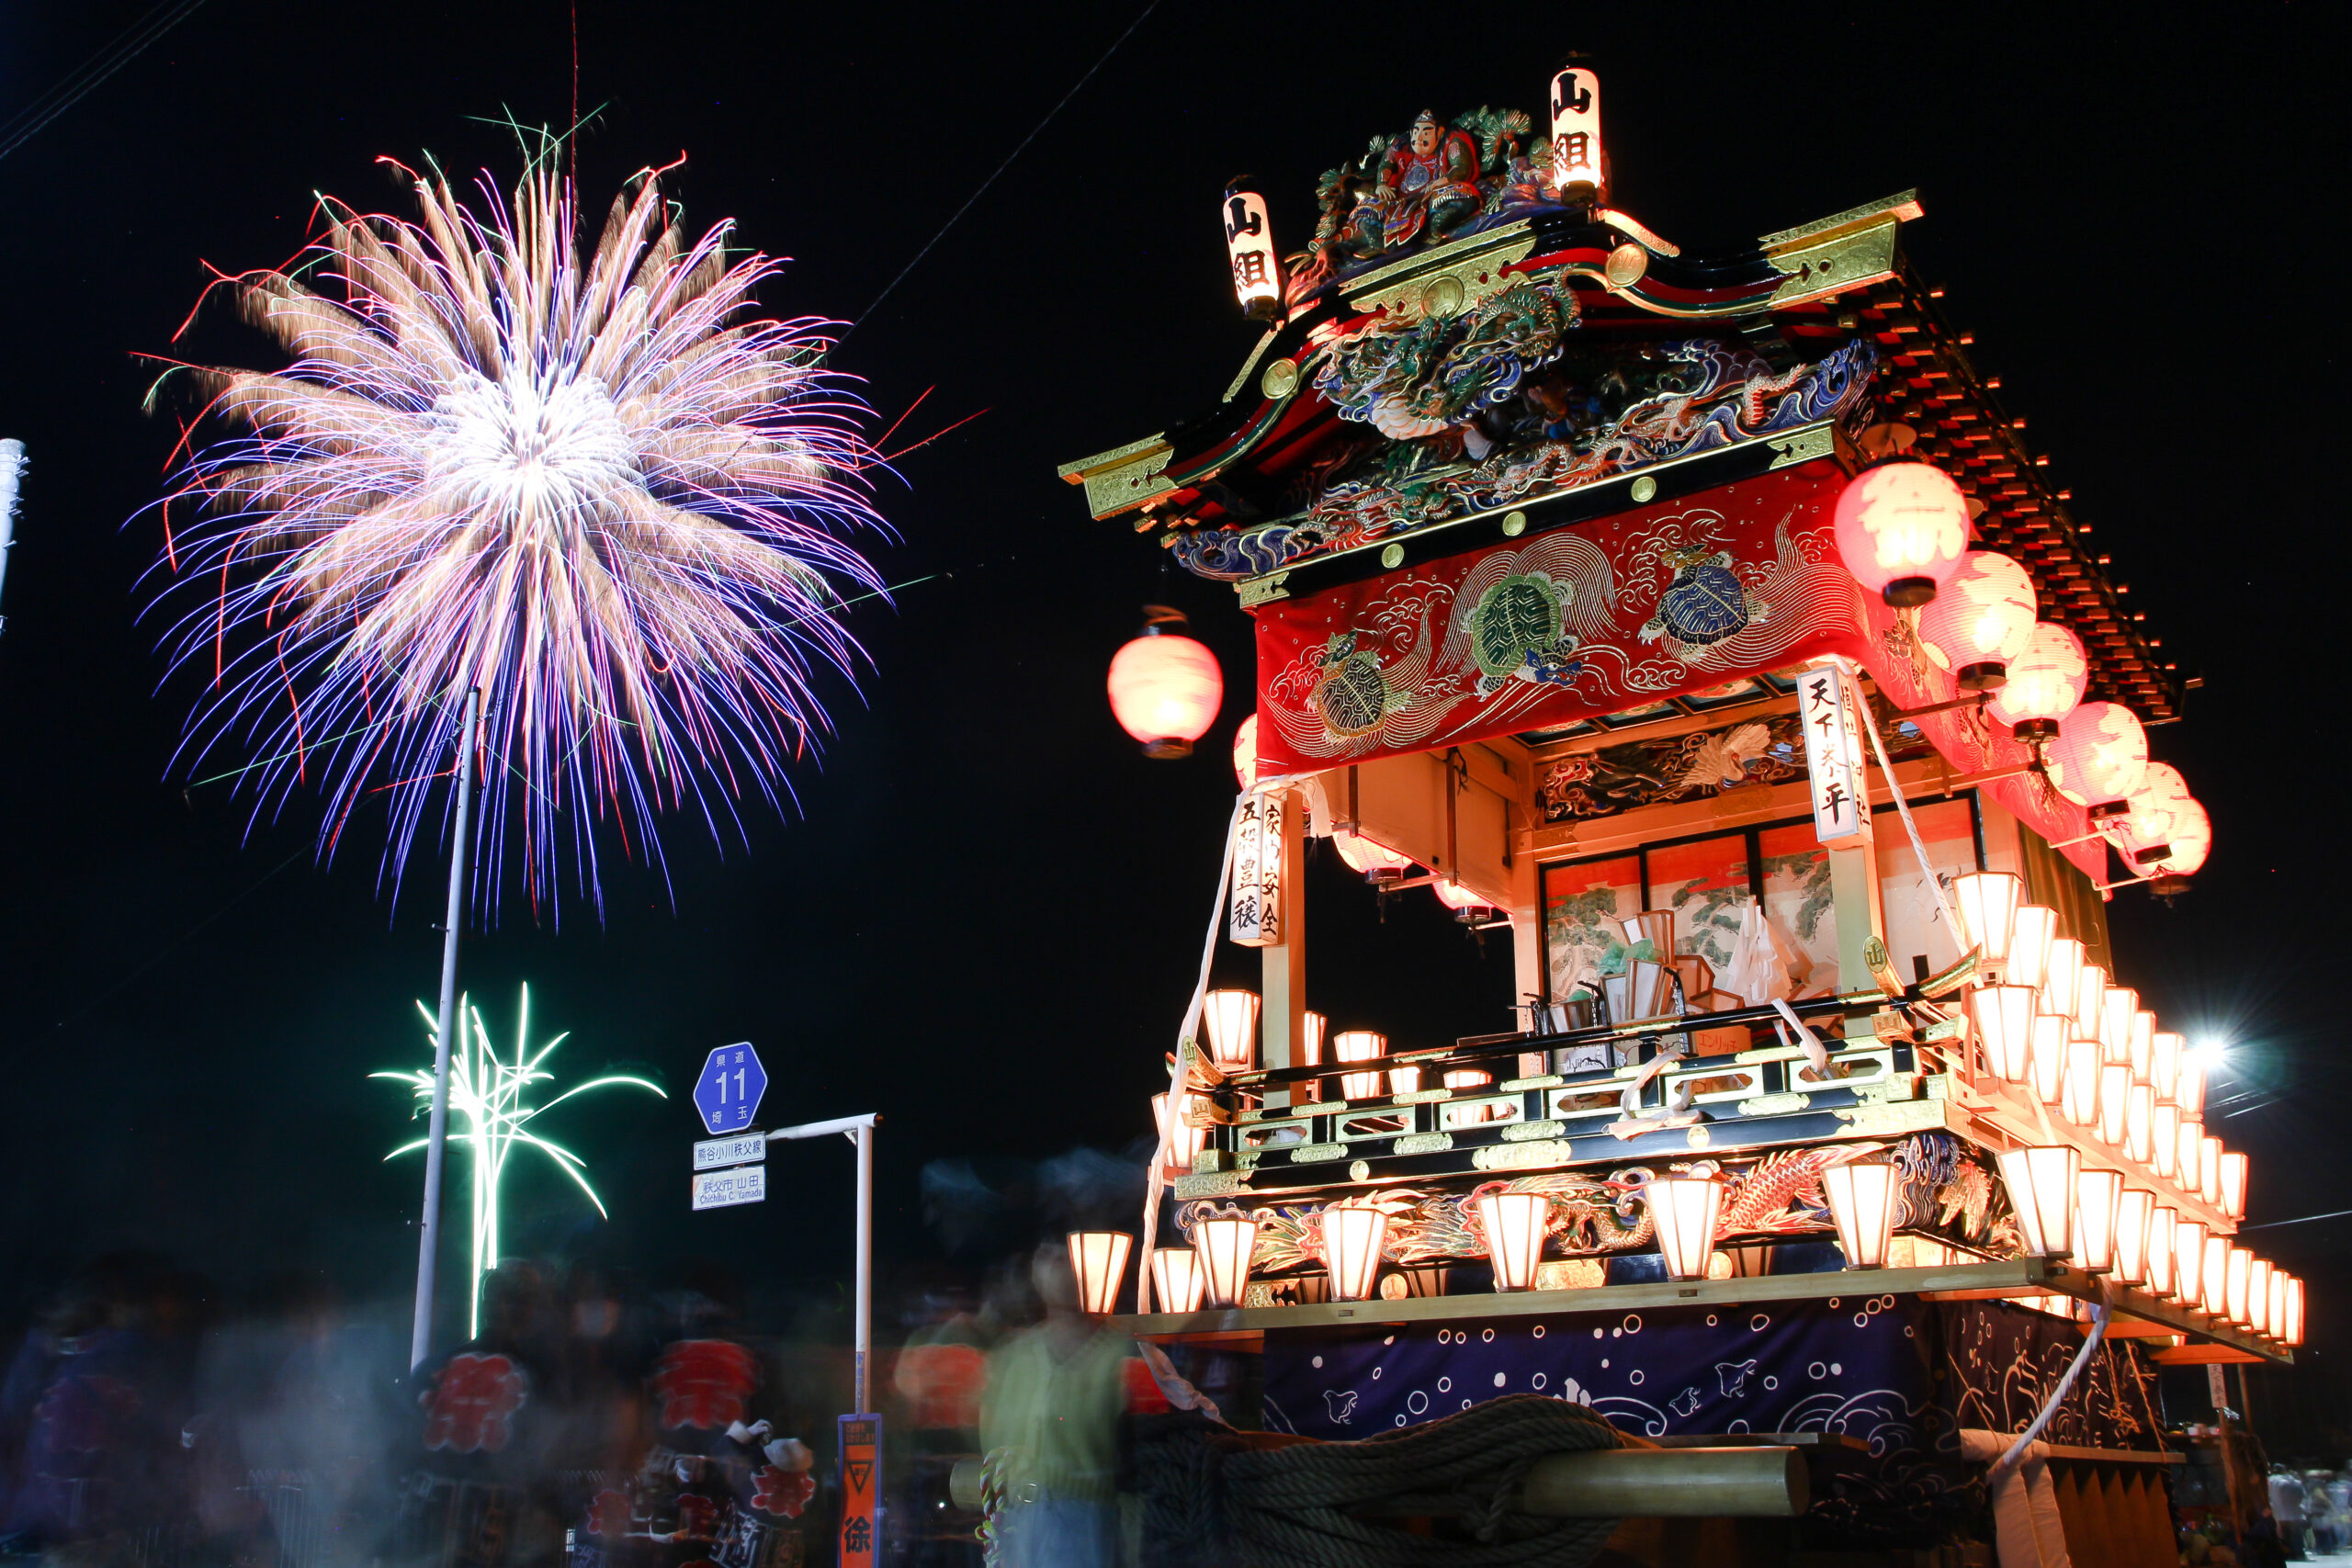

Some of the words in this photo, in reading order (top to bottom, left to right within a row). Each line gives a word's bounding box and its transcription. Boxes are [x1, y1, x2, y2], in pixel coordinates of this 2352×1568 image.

[1553, 72, 1592, 177] 山組
[1227, 197, 1270, 292] 山組
[1807, 677, 1850, 825] 天下泰平
[716, 1051, 745, 1067] 県道
[715, 1067, 745, 1104] 11
[711, 1105, 748, 1124] 埼玉
[697, 1140, 762, 1162] 熊谷小川秩父線
[704, 1179, 733, 1193] 秩父市
[737, 1175, 759, 1190] 山田
[699, 1193, 727, 1204] Chichibu
[739, 1188, 763, 1199] Yamada
